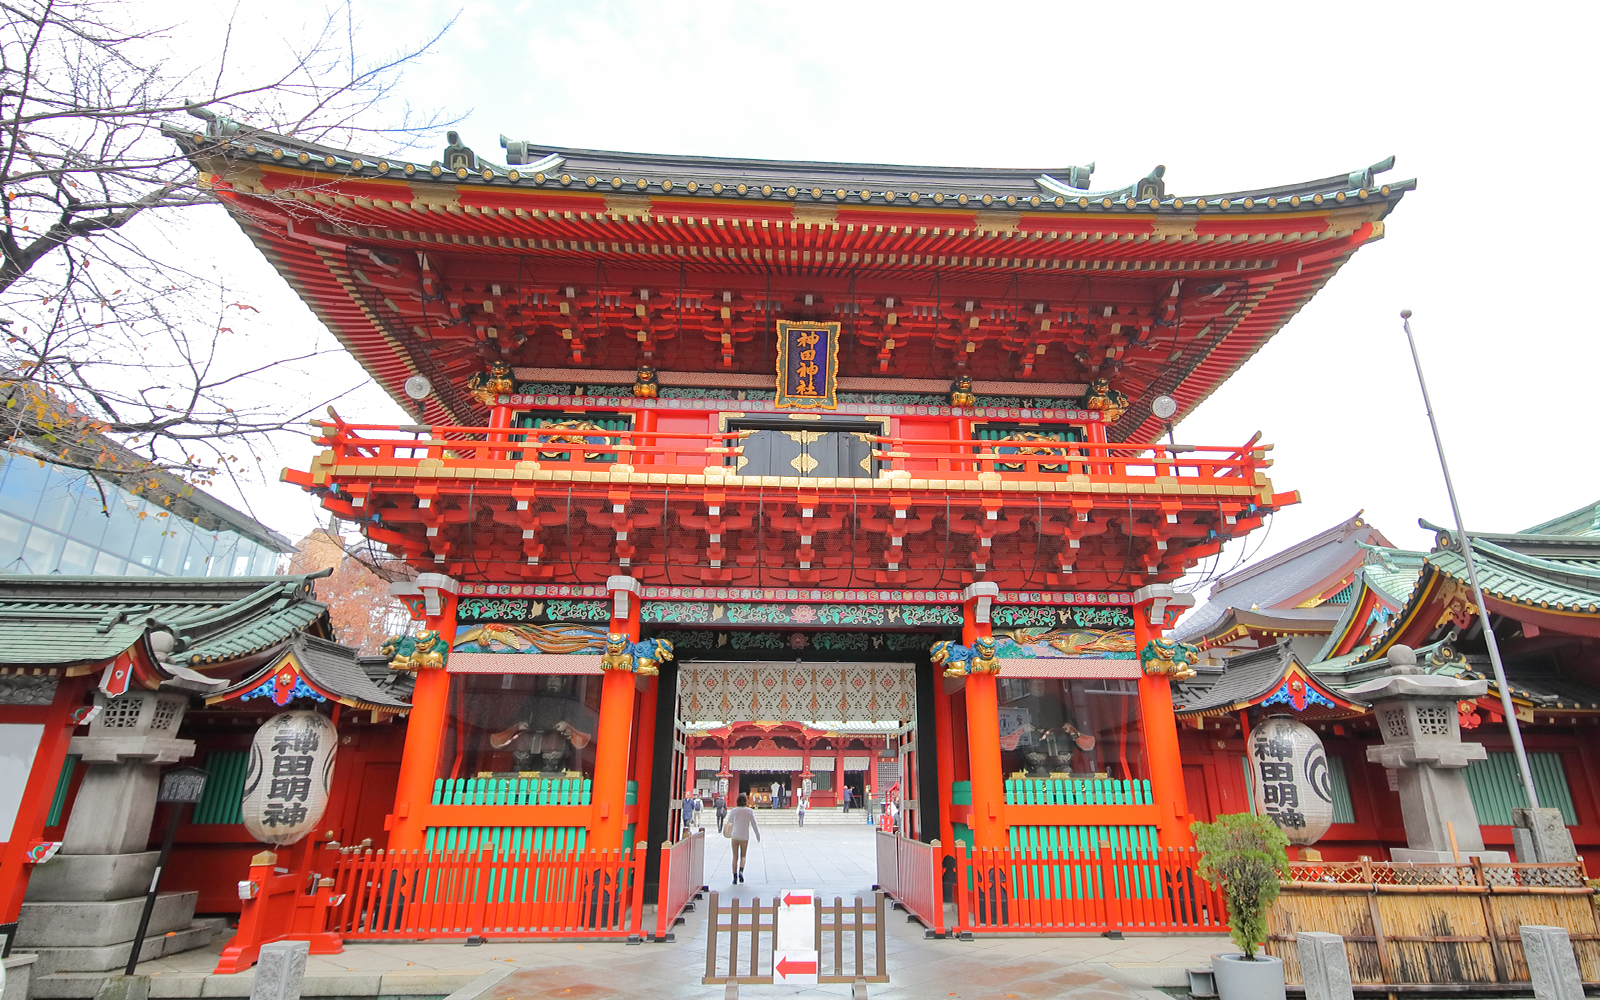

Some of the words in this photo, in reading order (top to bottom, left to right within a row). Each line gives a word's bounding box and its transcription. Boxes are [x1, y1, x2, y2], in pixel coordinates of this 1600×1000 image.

[796, 330, 820, 395] 神田神社
[262, 729, 320, 828] 神田明神
[1254, 737, 1307, 830] 神田明神
